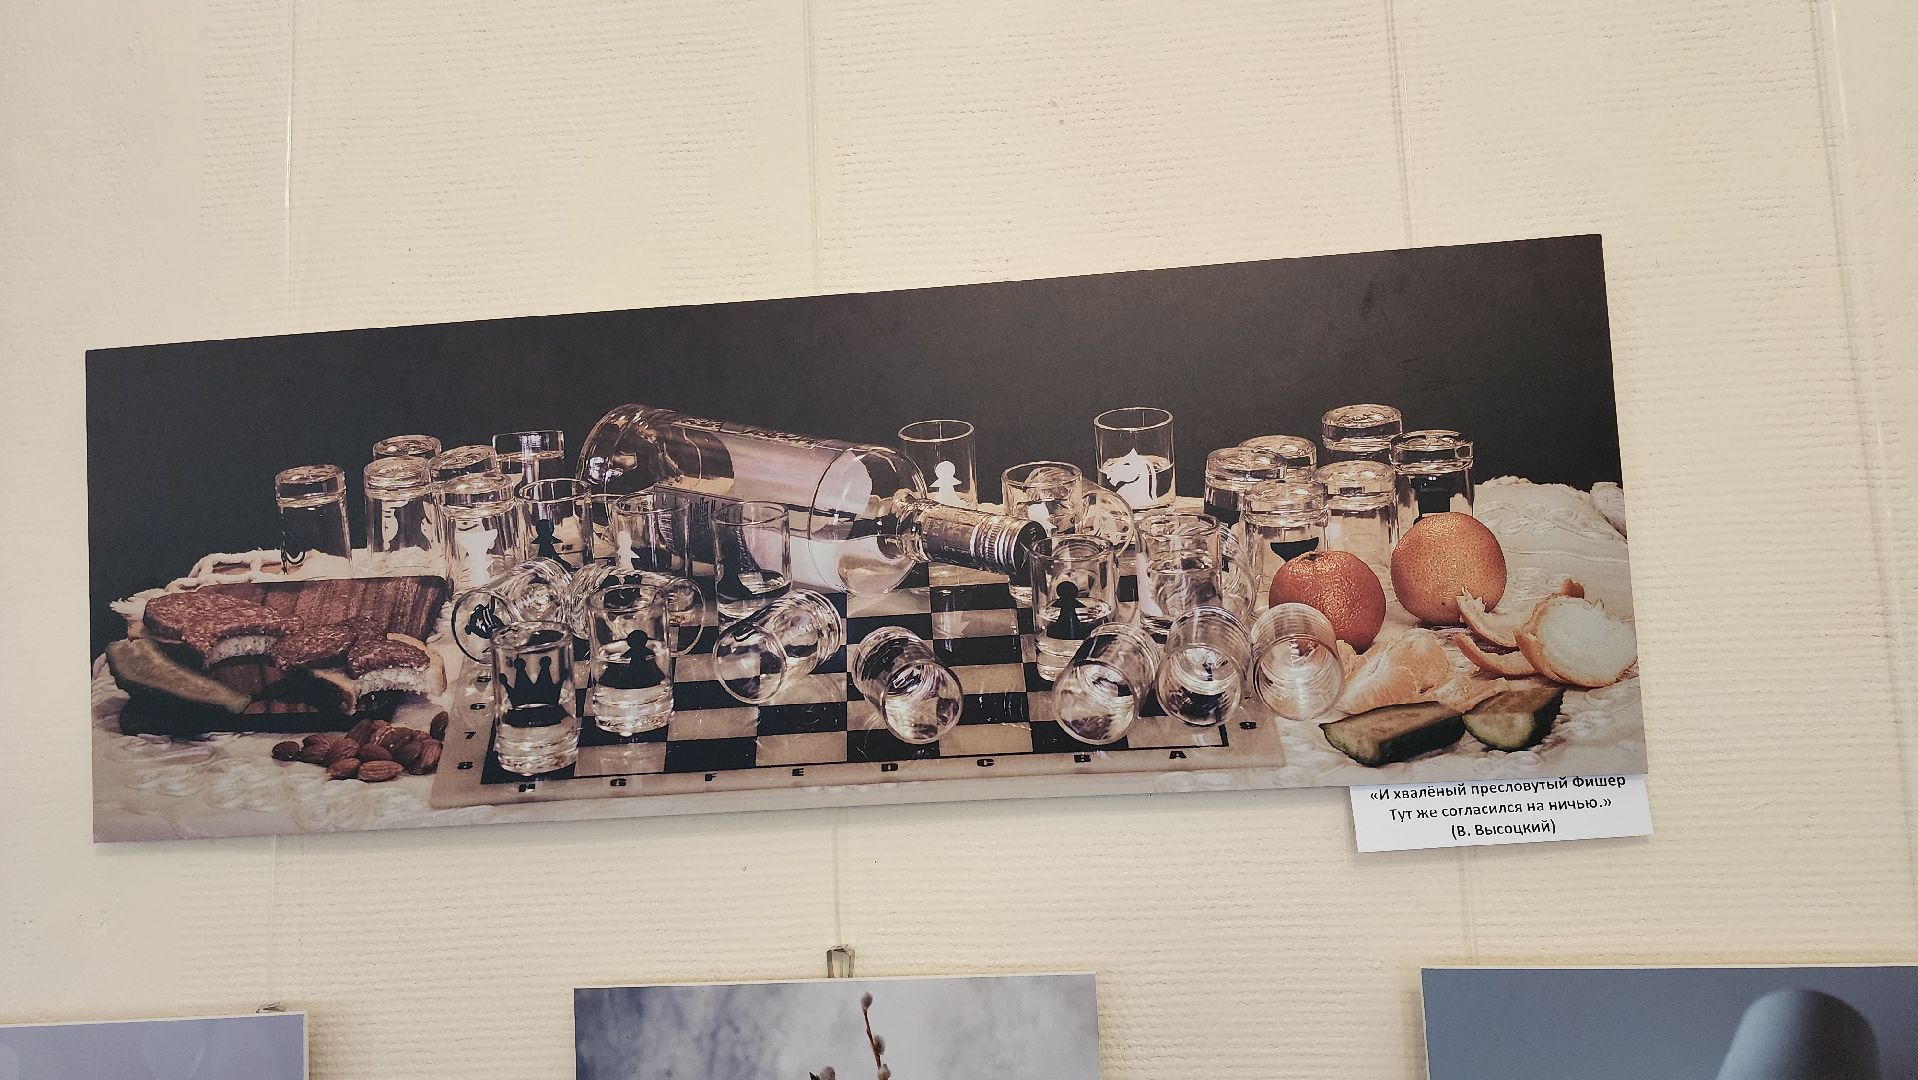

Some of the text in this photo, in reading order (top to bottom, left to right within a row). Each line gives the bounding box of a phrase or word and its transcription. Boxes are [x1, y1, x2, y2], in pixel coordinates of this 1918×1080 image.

[463, 731, 477, 740] 7
[704, 772, 718, 782] F
[791, 767, 805, 777] E
[881, 762, 899, 773] D
[976, 758, 995, 768] C
[1073, 753, 1092, 764] B
[1168, 750, 1188, 760] A
[1370, 775, 1626, 801] «И хвалёный пресловутый Фишер
[1389, 798, 1612, 822] Тут же согласился на ничью.»
[1451, 818, 1557, 841] (В. Высоцкий)
